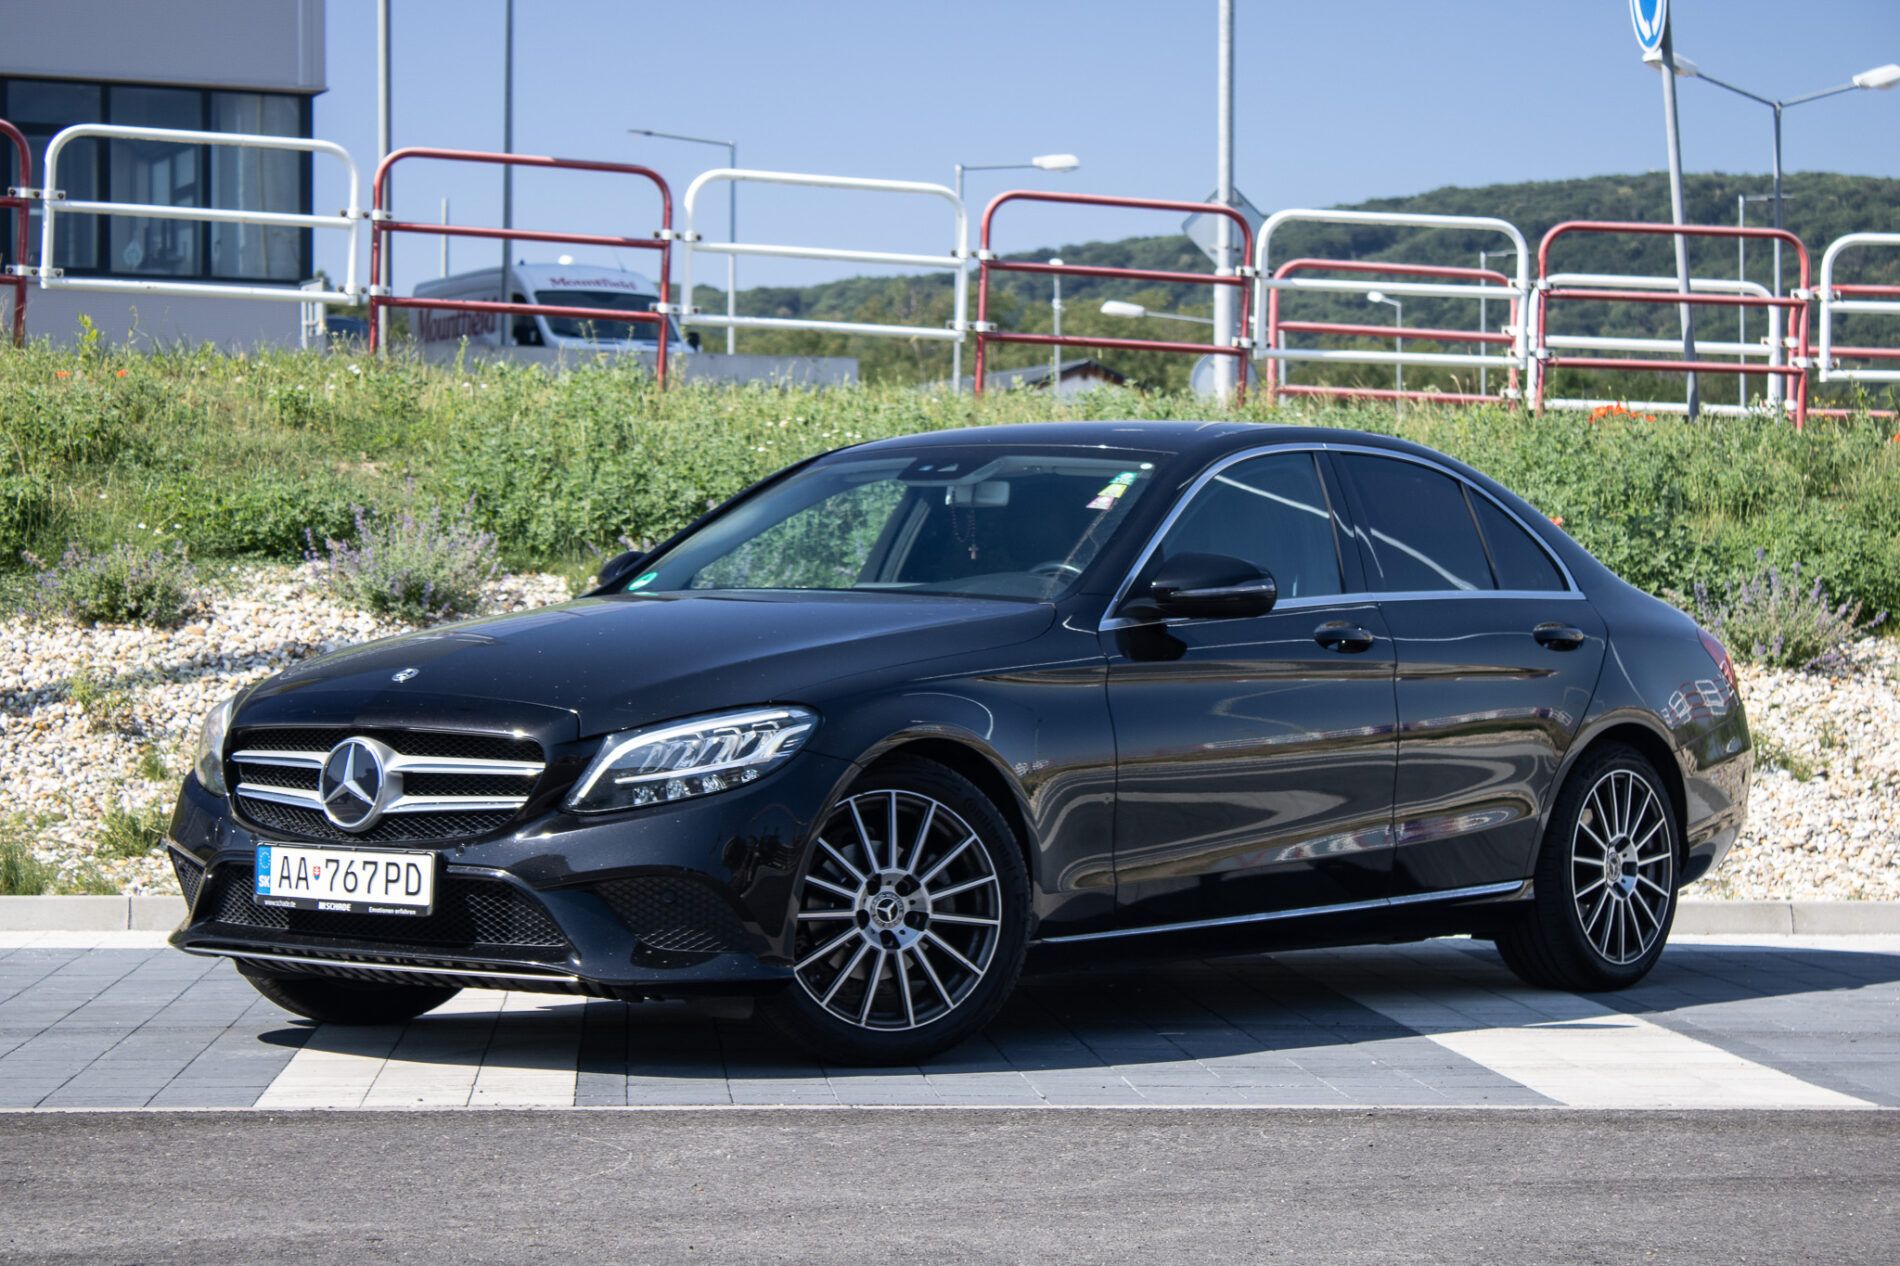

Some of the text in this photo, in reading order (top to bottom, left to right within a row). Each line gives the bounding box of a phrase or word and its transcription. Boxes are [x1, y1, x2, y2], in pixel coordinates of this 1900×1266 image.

[257, 875, 271, 888] SK
[278, 855, 422, 896] AA 767PD
